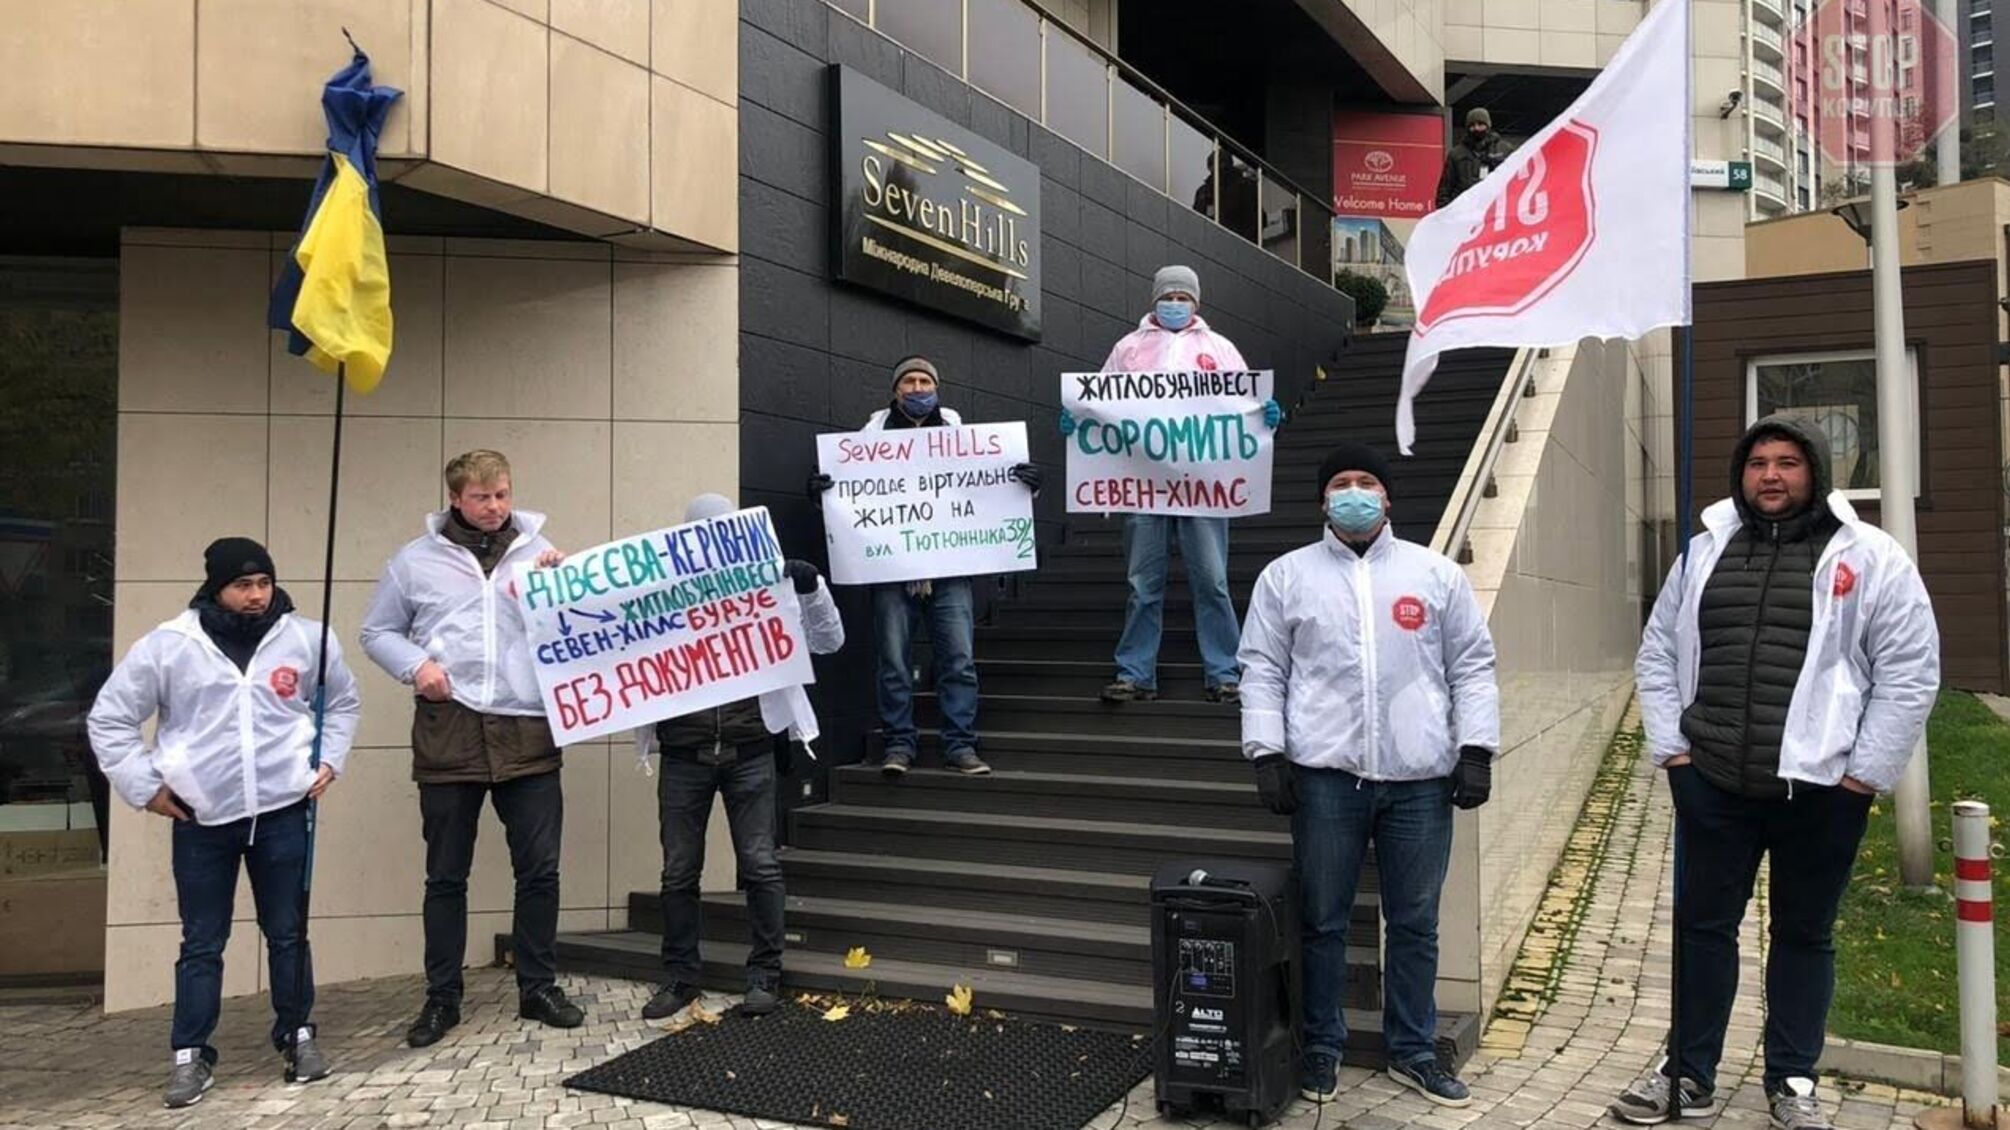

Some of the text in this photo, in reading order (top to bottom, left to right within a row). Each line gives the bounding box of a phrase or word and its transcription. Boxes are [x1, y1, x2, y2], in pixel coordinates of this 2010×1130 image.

[1351, 172, 1406, 182] PARK AVENUE
[1733, 168, 1747, 180] 58
[1388, 197, 1423, 211] Home
[862, 236, 929, 276] Міжнародна
[930, 262, 1002, 302] Девелоперська
[1076, 370, 1260, 401] ЖИТЛОБУДІНВЕСТ
[1077, 413, 1259, 463] СОРОМИТЬ
[1076, 473, 1248, 508] СЕВЕН-ХІЛЛС
[619, 559, 782, 622] ЖИТЛОБУДІНВЕСТ
[538, 588, 777, 666] СЕВЕН-ХІЛЛС БУДУЄ
[553, 613, 793, 730] БЕЗ ДОКУМЕНТІВ
[1191, 1006, 1224, 1021] ALTO
